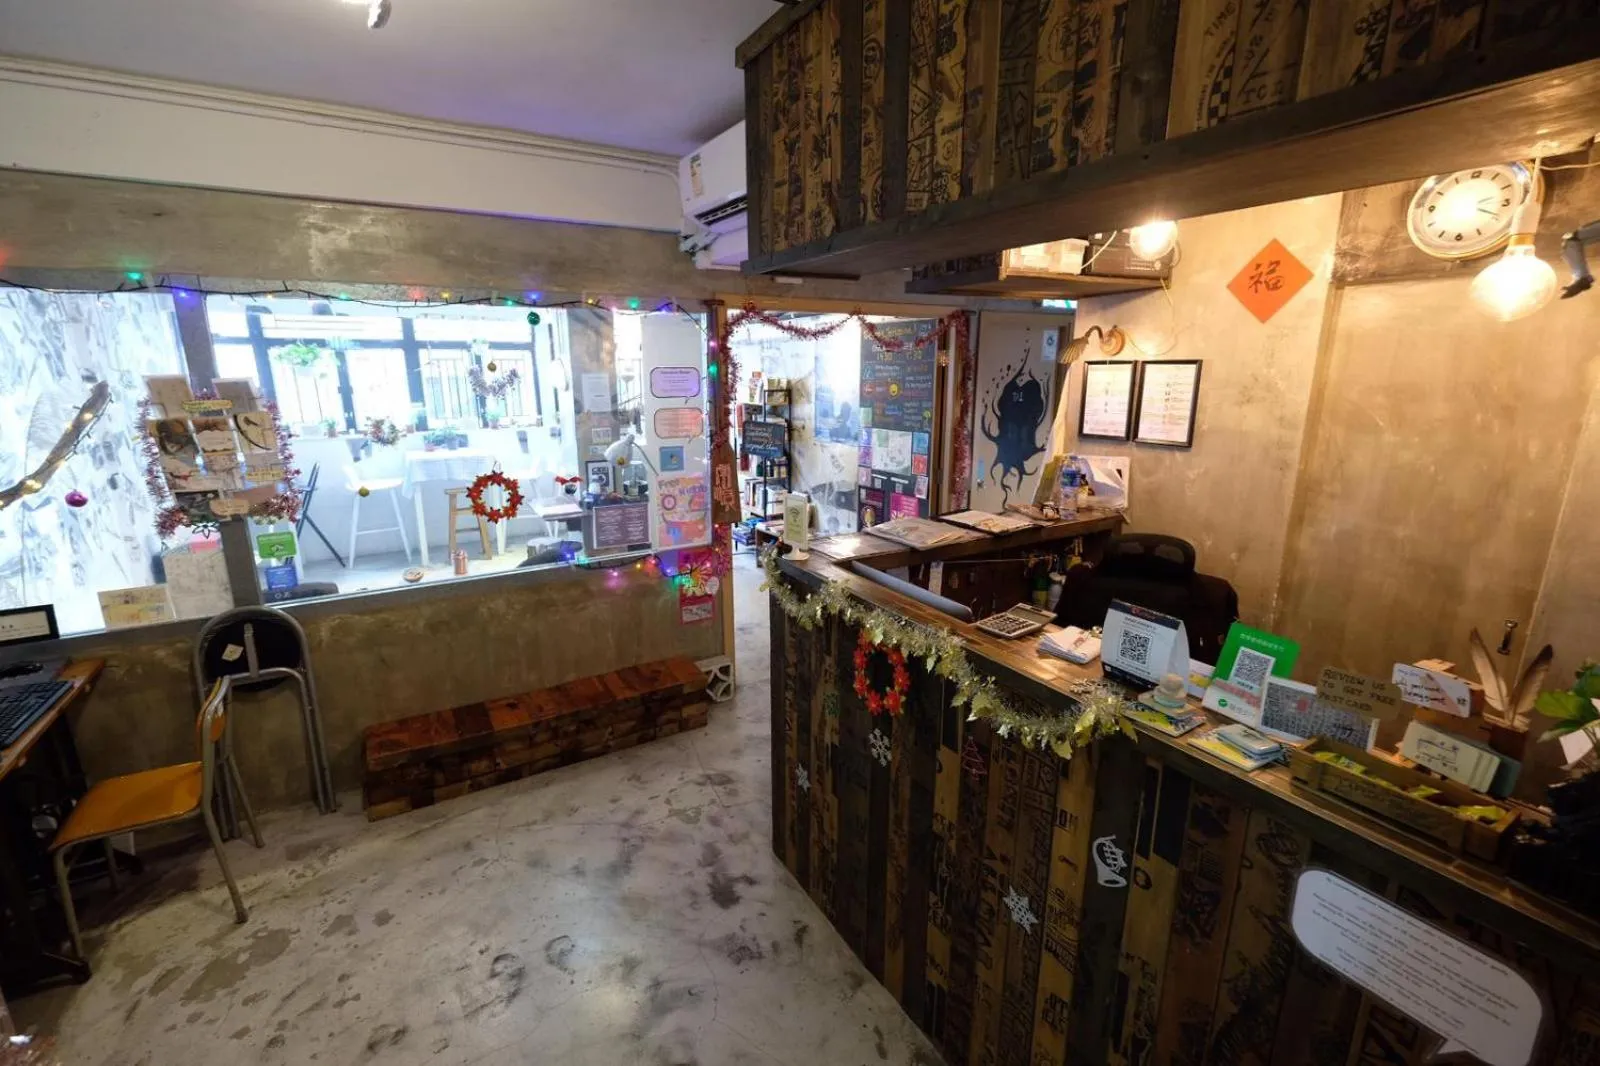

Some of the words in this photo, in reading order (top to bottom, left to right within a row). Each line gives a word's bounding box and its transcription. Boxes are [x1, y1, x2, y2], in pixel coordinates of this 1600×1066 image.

[1502, 199, 1510, 207] 3
[1247, 260, 1284, 294] 福
[1323, 669, 1366, 685] REVIEW
[1371, 682, 1386, 691] US
